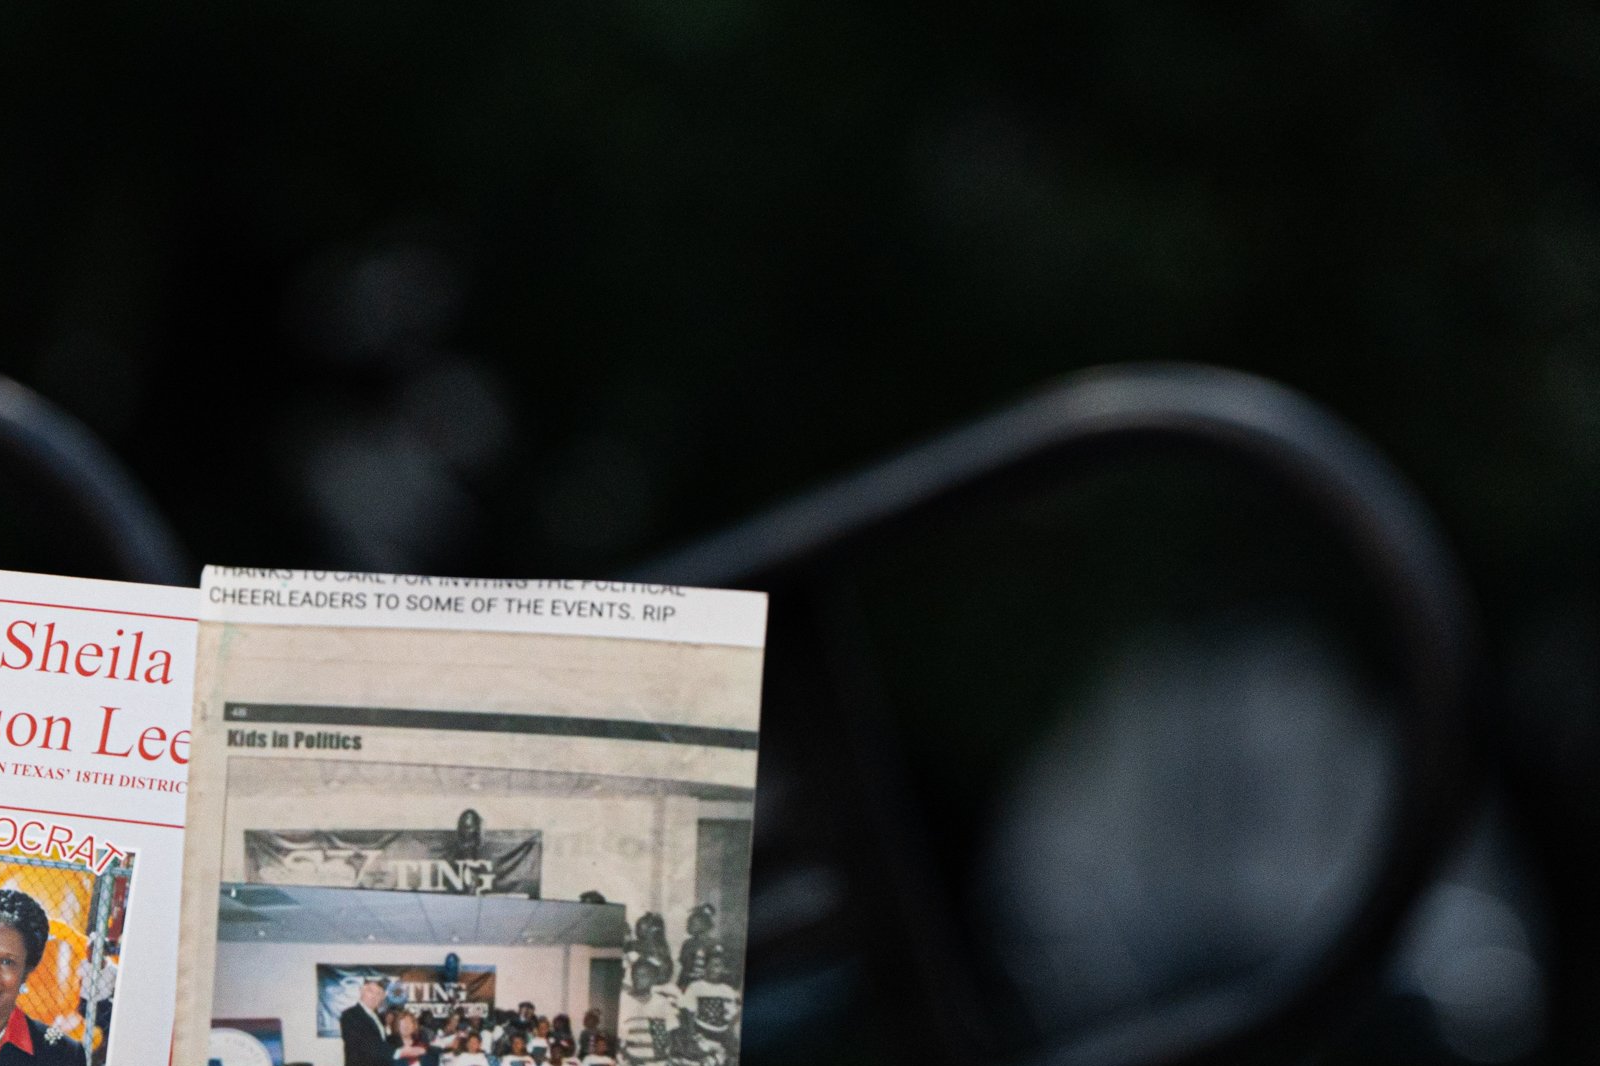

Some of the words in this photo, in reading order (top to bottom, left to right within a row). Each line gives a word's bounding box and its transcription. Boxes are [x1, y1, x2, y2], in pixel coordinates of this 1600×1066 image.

[209, 586, 368, 610] CHEERLEADERS
[374, 593, 400, 610] TO
[406, 594, 466, 614] SOME
[472, 596, 498, 614] OF
[504, 597, 544, 616] THE
[550, 599, 635, 620] EVENTS.
[642, 603, 676, 622] RIP
[0, 620, 174, 685] Sheila
[91, 705, 191, 765] Lee
[227, 729, 267, 748] Kids
[294, 731, 362, 750] Politics
[75, 769, 114, 787] 18TH
